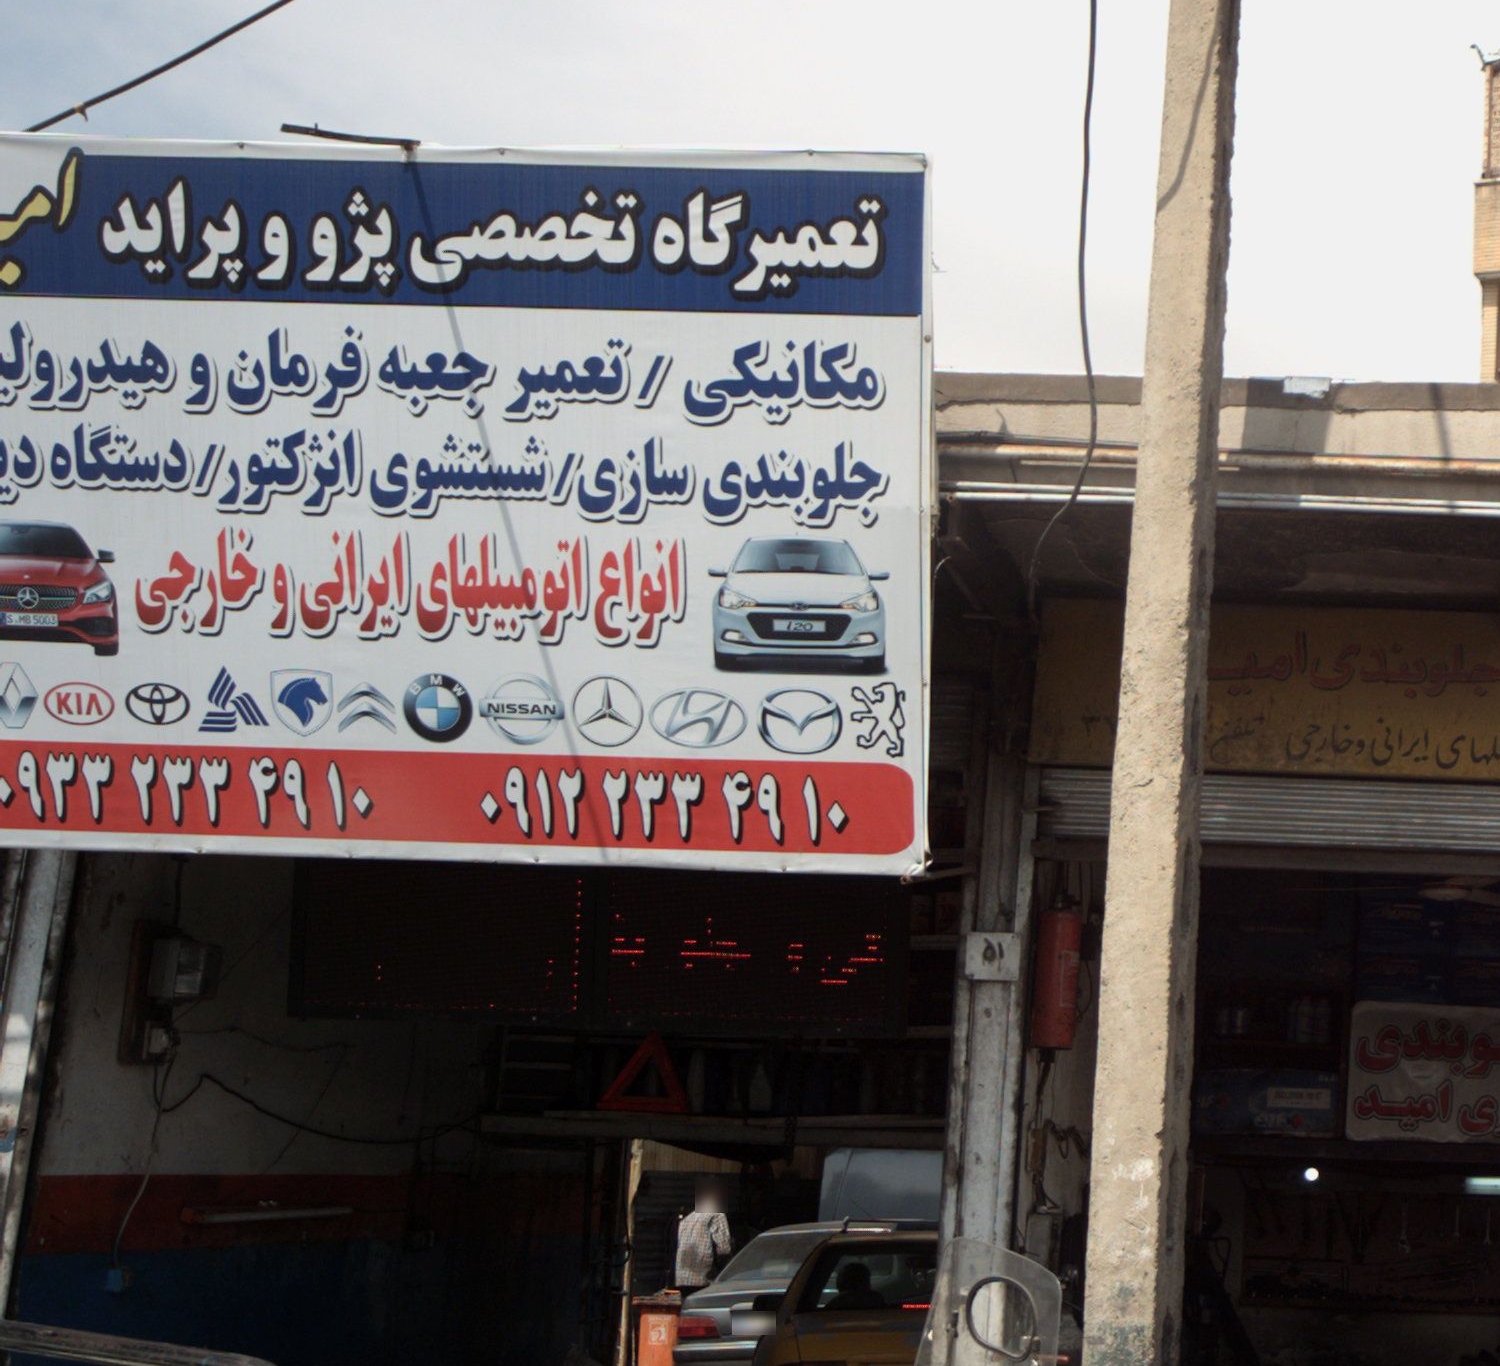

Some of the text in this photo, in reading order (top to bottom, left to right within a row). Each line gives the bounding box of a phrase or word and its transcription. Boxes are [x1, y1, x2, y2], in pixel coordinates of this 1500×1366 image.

[101, 177, 884, 294] تعمیرگاه تخصصی پژو و پراید
[185, 351, 214, 411] و
[226, 326, 367, 415] فرمان
[378, 344, 494, 415] جعبه
[503, 337, 628, 417] تعمیر
[684, 337, 884, 421] مکانیکی
[703, 440, 888, 523] جلوبندی
[134, 527, 683, 641] انواع اتومبیلهای ایرانی و خارجی
[1208, 630, 1309, 696] امی
[56, 691, 103, 716] KIA
[486, 701, 557, 717] NISSAN
[1369, 717, 1430, 767] ایرانی
[1354, 1079, 1454, 1131] امید
